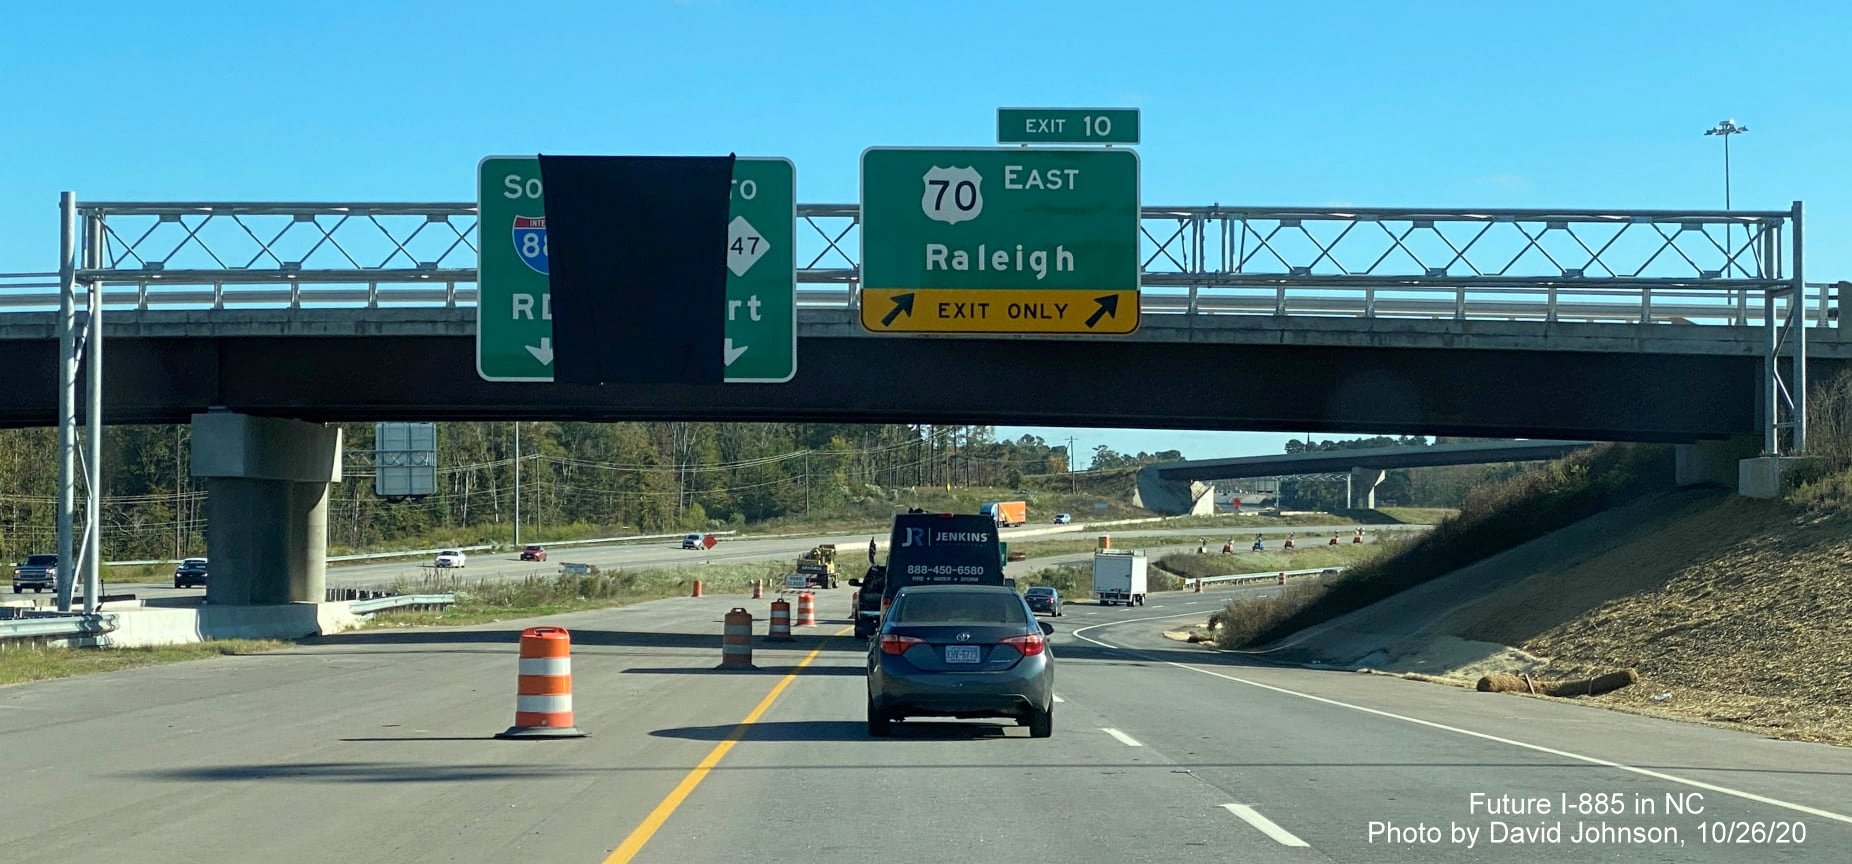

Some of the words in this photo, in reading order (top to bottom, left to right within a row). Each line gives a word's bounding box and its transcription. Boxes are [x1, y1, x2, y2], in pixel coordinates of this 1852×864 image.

[1025, 118, 1066, 133] EXIT
[1083, 115, 1112, 136] 10
[1004, 165, 1079, 190] EAST
[928, 179, 977, 211] 70
[522, 232, 548, 258] 8
[730, 236, 760, 255] 47
[926, 243, 1075, 280] Raleigh
[728, 294, 762, 321] rt
[938, 302, 990, 319] EXIT
[1007, 303, 1069, 319] ONLY
[935, 531, 988, 542] JENKINS
[907, 565, 984, 575] 888-450-6580
